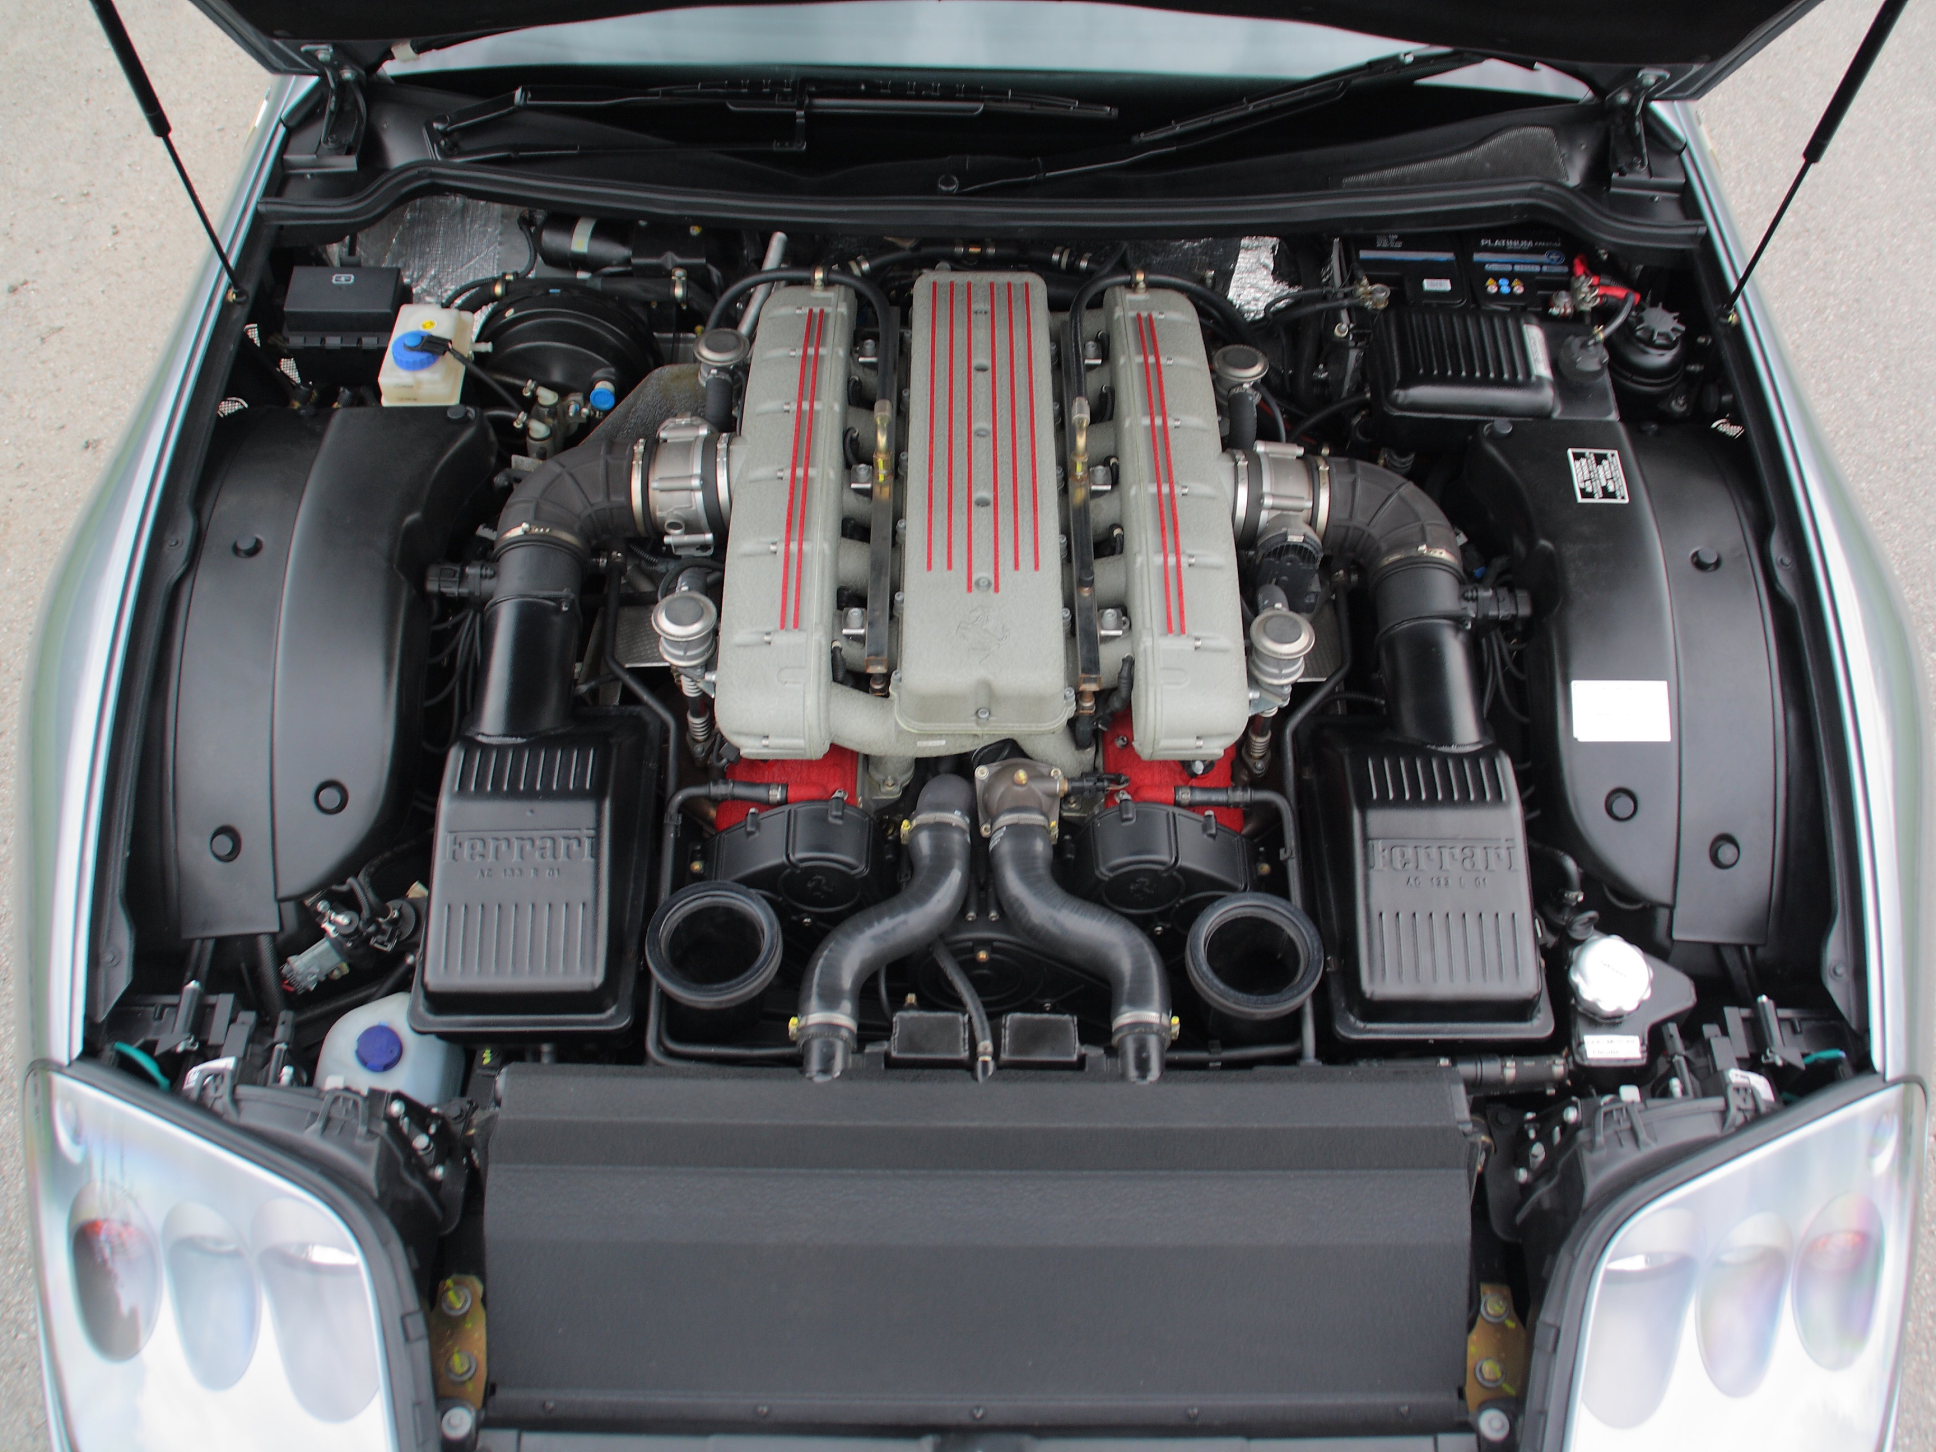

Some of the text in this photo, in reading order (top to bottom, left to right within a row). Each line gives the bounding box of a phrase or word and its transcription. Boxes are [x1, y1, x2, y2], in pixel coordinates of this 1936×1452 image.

[1480, 238, 1533, 248] PLATINUM
[446, 829, 596, 862] Ferrari
[1368, 838, 1519, 872] Ferrari
